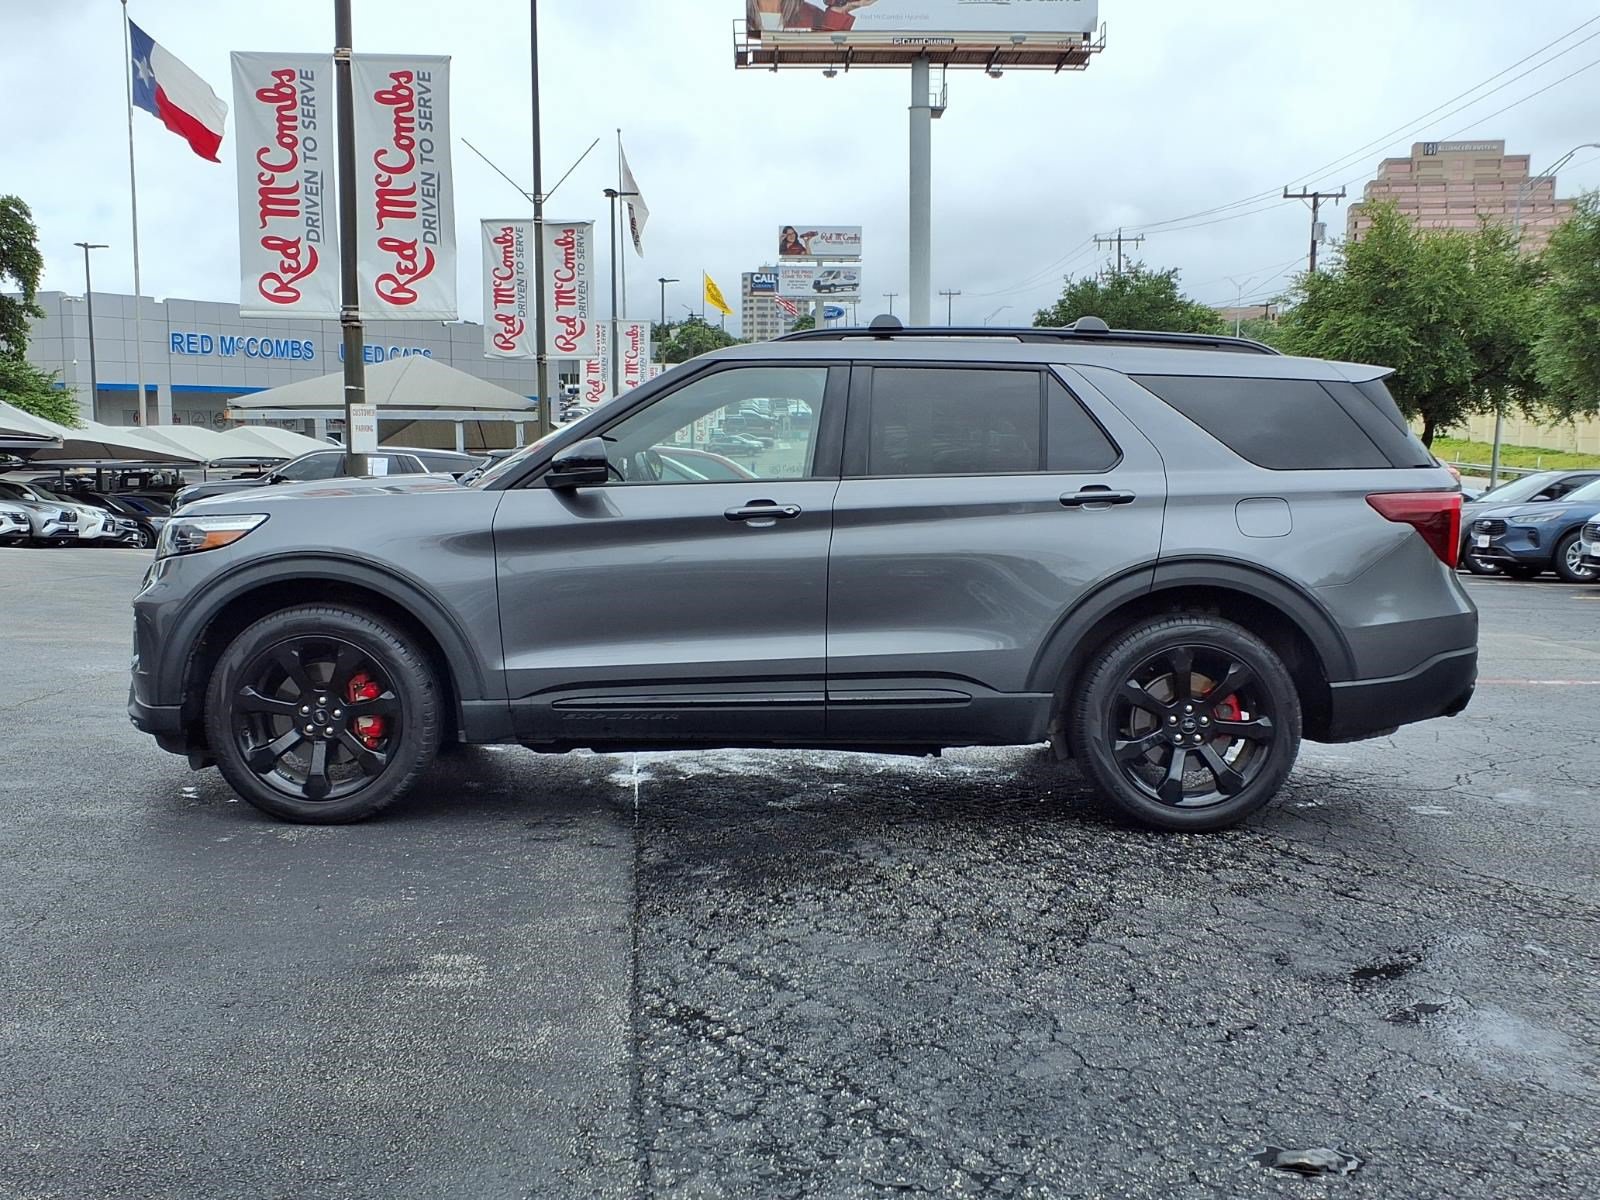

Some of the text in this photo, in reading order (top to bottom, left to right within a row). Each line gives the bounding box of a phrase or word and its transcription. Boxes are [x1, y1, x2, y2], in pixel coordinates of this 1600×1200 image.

[256, 69, 319, 304] Red McCombs
[300, 69, 321, 243] DRIVEN TO SERVE
[374, 70, 435, 305] Red McCombs
[417, 70, 438, 245] DRIVEN TO SERVE
[493, 226, 525, 351] Red McCombs
[515, 226, 526, 318] DRIVEN TO SERVE
[554, 228, 586, 352] Red McCombs
[576, 228, 588, 319] DRIVEN TO SERVE
[752, 273, 776, 283] CALL
[171, 332, 214, 354] RED
[340, 344, 385, 363] ED
[352, 408, 375, 417] CUSTOMER
[355, 424, 374, 433] PARKING
[586, 379, 606, 403] Red
